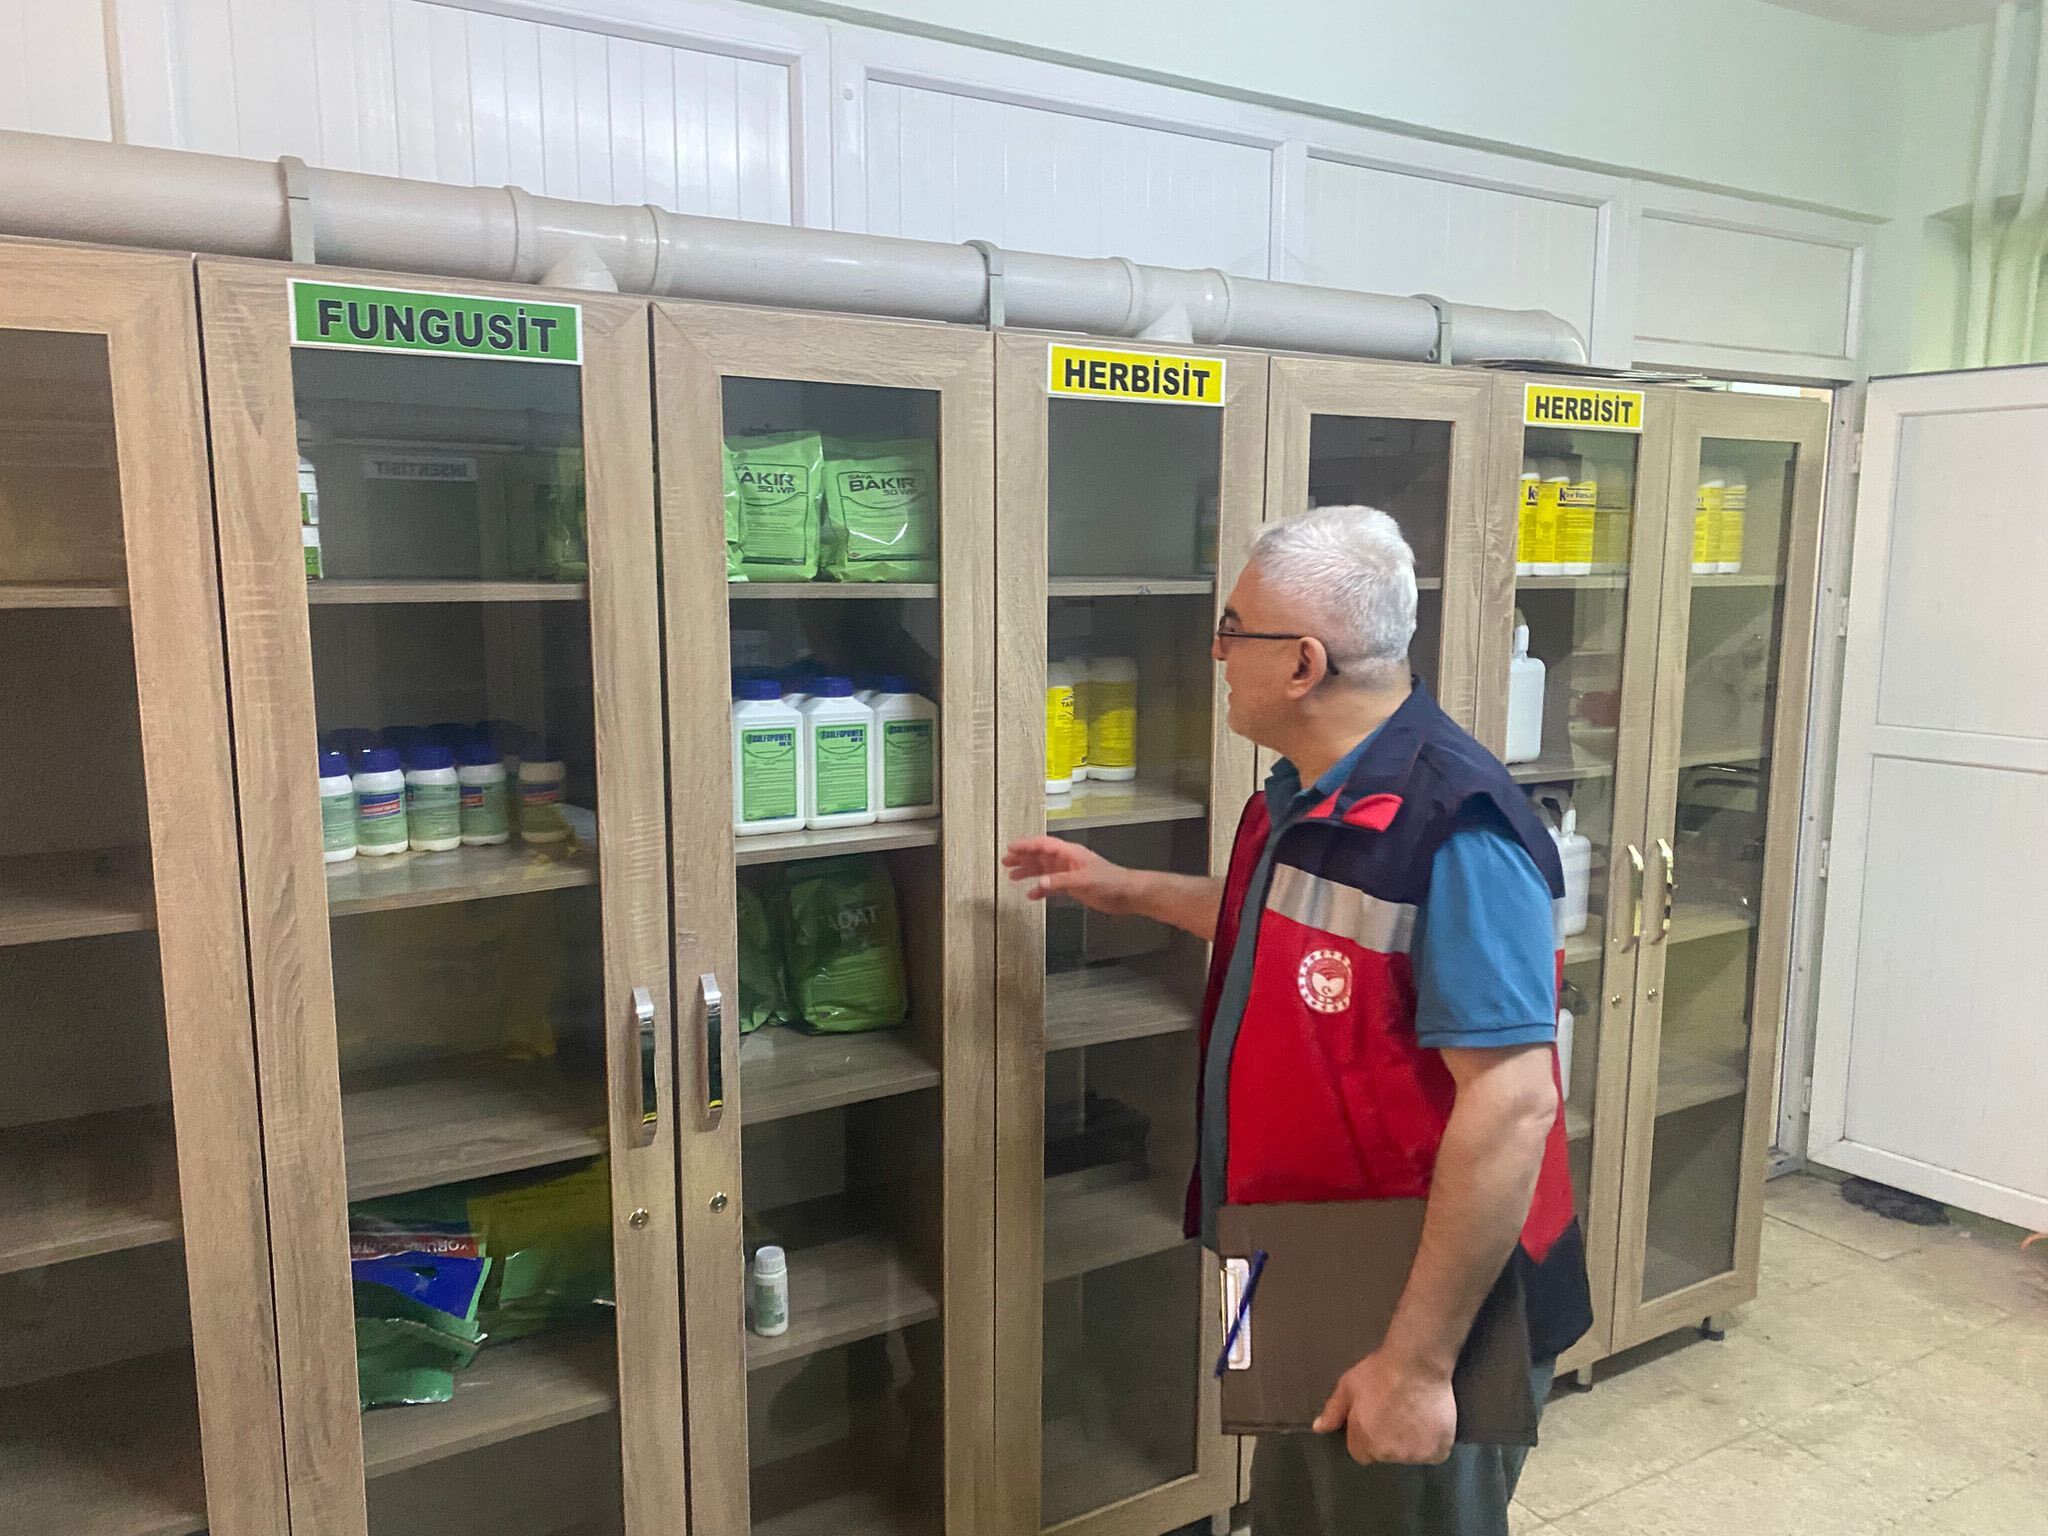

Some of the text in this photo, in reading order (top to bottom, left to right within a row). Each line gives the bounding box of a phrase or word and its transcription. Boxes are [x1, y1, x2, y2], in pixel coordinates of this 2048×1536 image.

[317, 298, 558, 353] FUNGUSİT
[1064, 357, 1211, 398] HERBİSİT
[1534, 392, 1634, 424] HERBİSİT
[735, 471, 795, 487] AKIR
[848, 477, 916, 493] BAKIR
